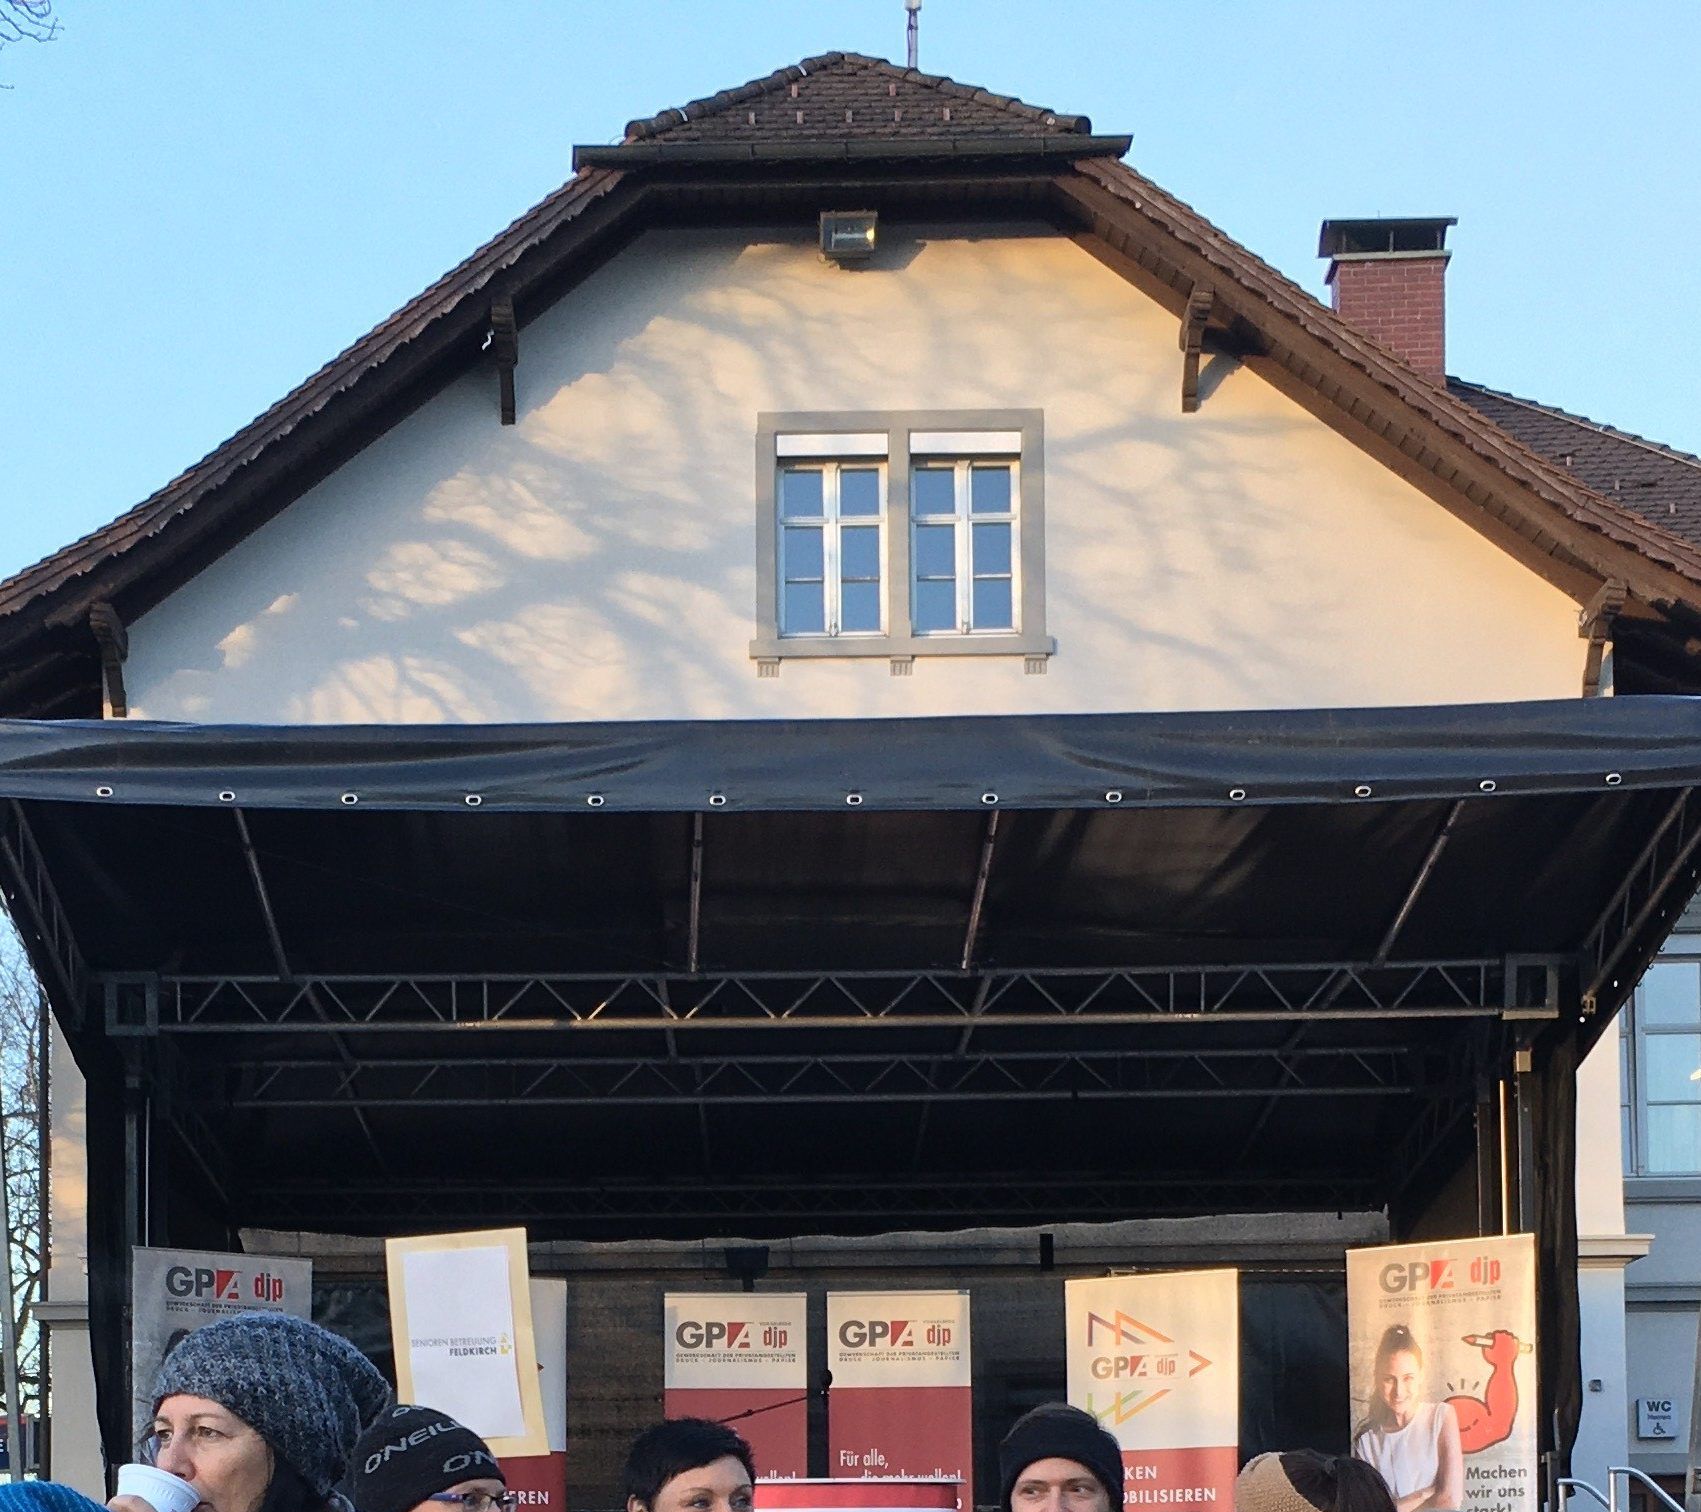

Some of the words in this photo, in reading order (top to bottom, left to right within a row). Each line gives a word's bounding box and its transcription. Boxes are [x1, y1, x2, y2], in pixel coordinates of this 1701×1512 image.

[1379, 1260, 1454, 1294] GPA
[1470, 1255, 1501, 1285] djp
[166, 1266, 240, 1299] GPA
[254, 1272, 284, 1302] djp
[675, 1321, 751, 1349] GPA
[763, 1326, 788, 1349] djp
[838, 1320, 914, 1349] GPA
[926, 1323, 952, 1347] djp
[449, 1346, 497, 1356] FELDKIRCH
[1091, 1356, 1147, 1380] GPA
[1156, 1357, 1176, 1376] djp
[1647, 1400, 1671, 1412] WC
[840, 1450, 859, 1467] Für
[863, 1449, 888, 1469] alle,
[1124, 1466, 1157, 1480] KEN
[1466, 1464, 1527, 1480] Machen
[508, 1490, 549, 1505] REN
[1123, 1488, 1216, 1504] BILISIEREN
[1465, 1485, 1492, 1498] wir
[1497, 1487, 1525, 1498] uns
